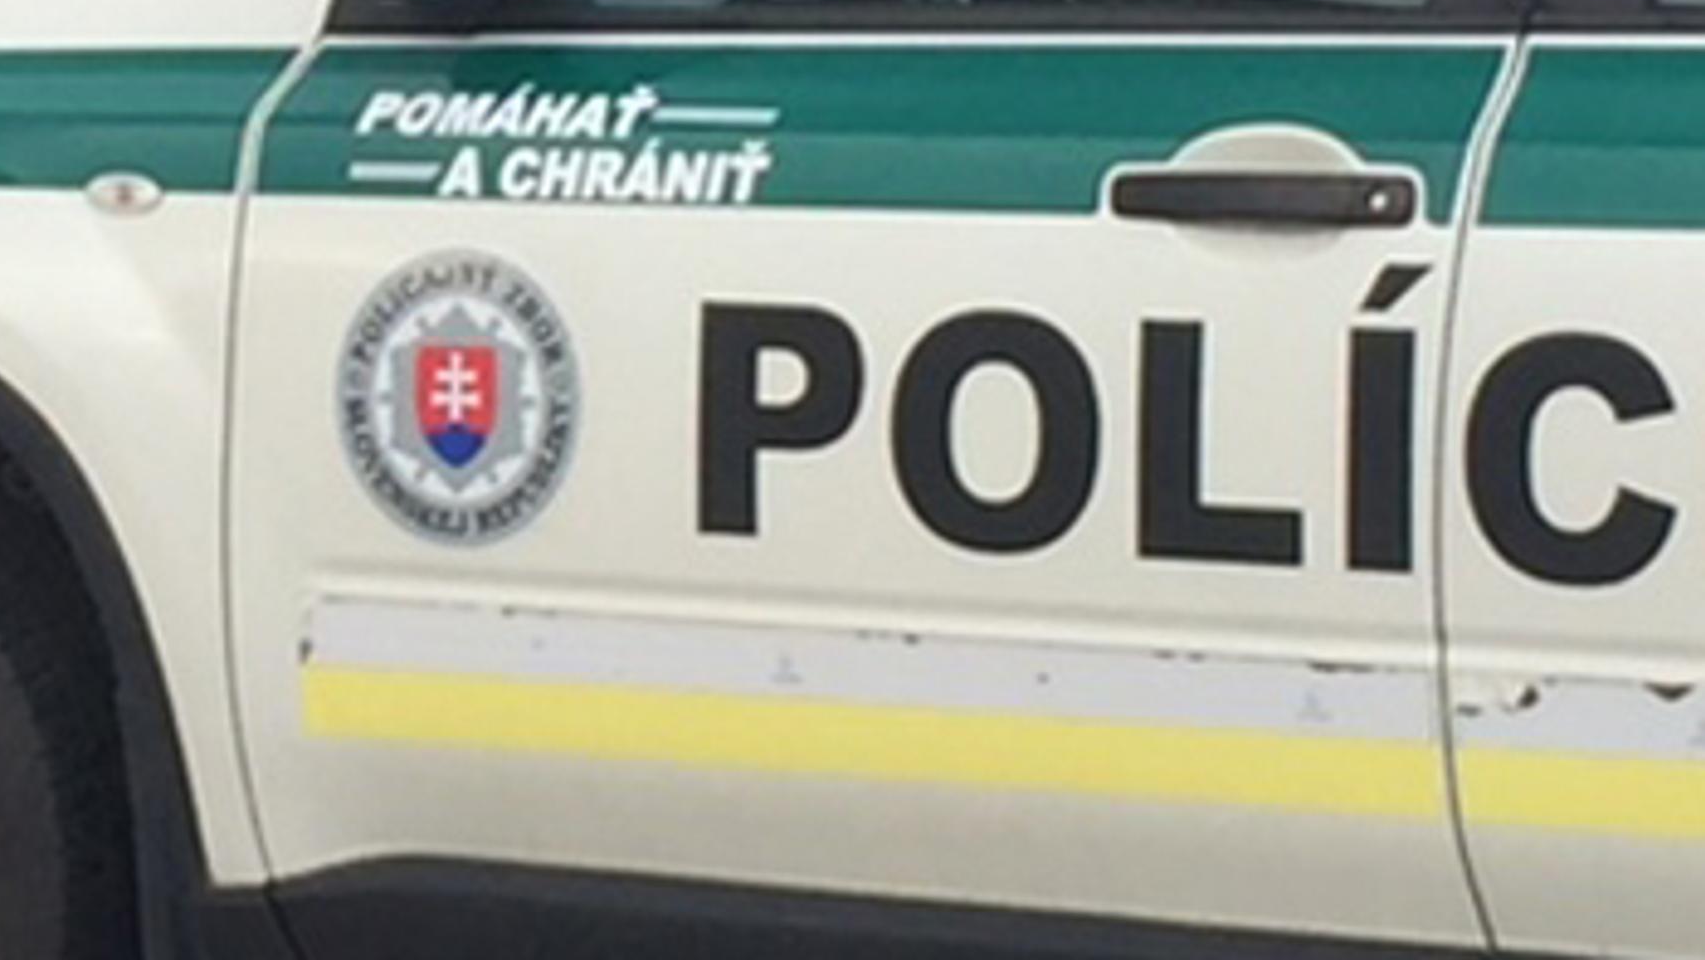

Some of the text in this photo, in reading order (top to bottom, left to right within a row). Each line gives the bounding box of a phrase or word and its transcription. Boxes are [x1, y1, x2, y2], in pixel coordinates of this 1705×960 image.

[355, 83, 660, 138] POMÁHAŤ
[437, 138, 772, 203] A CHRÁNIŤ
